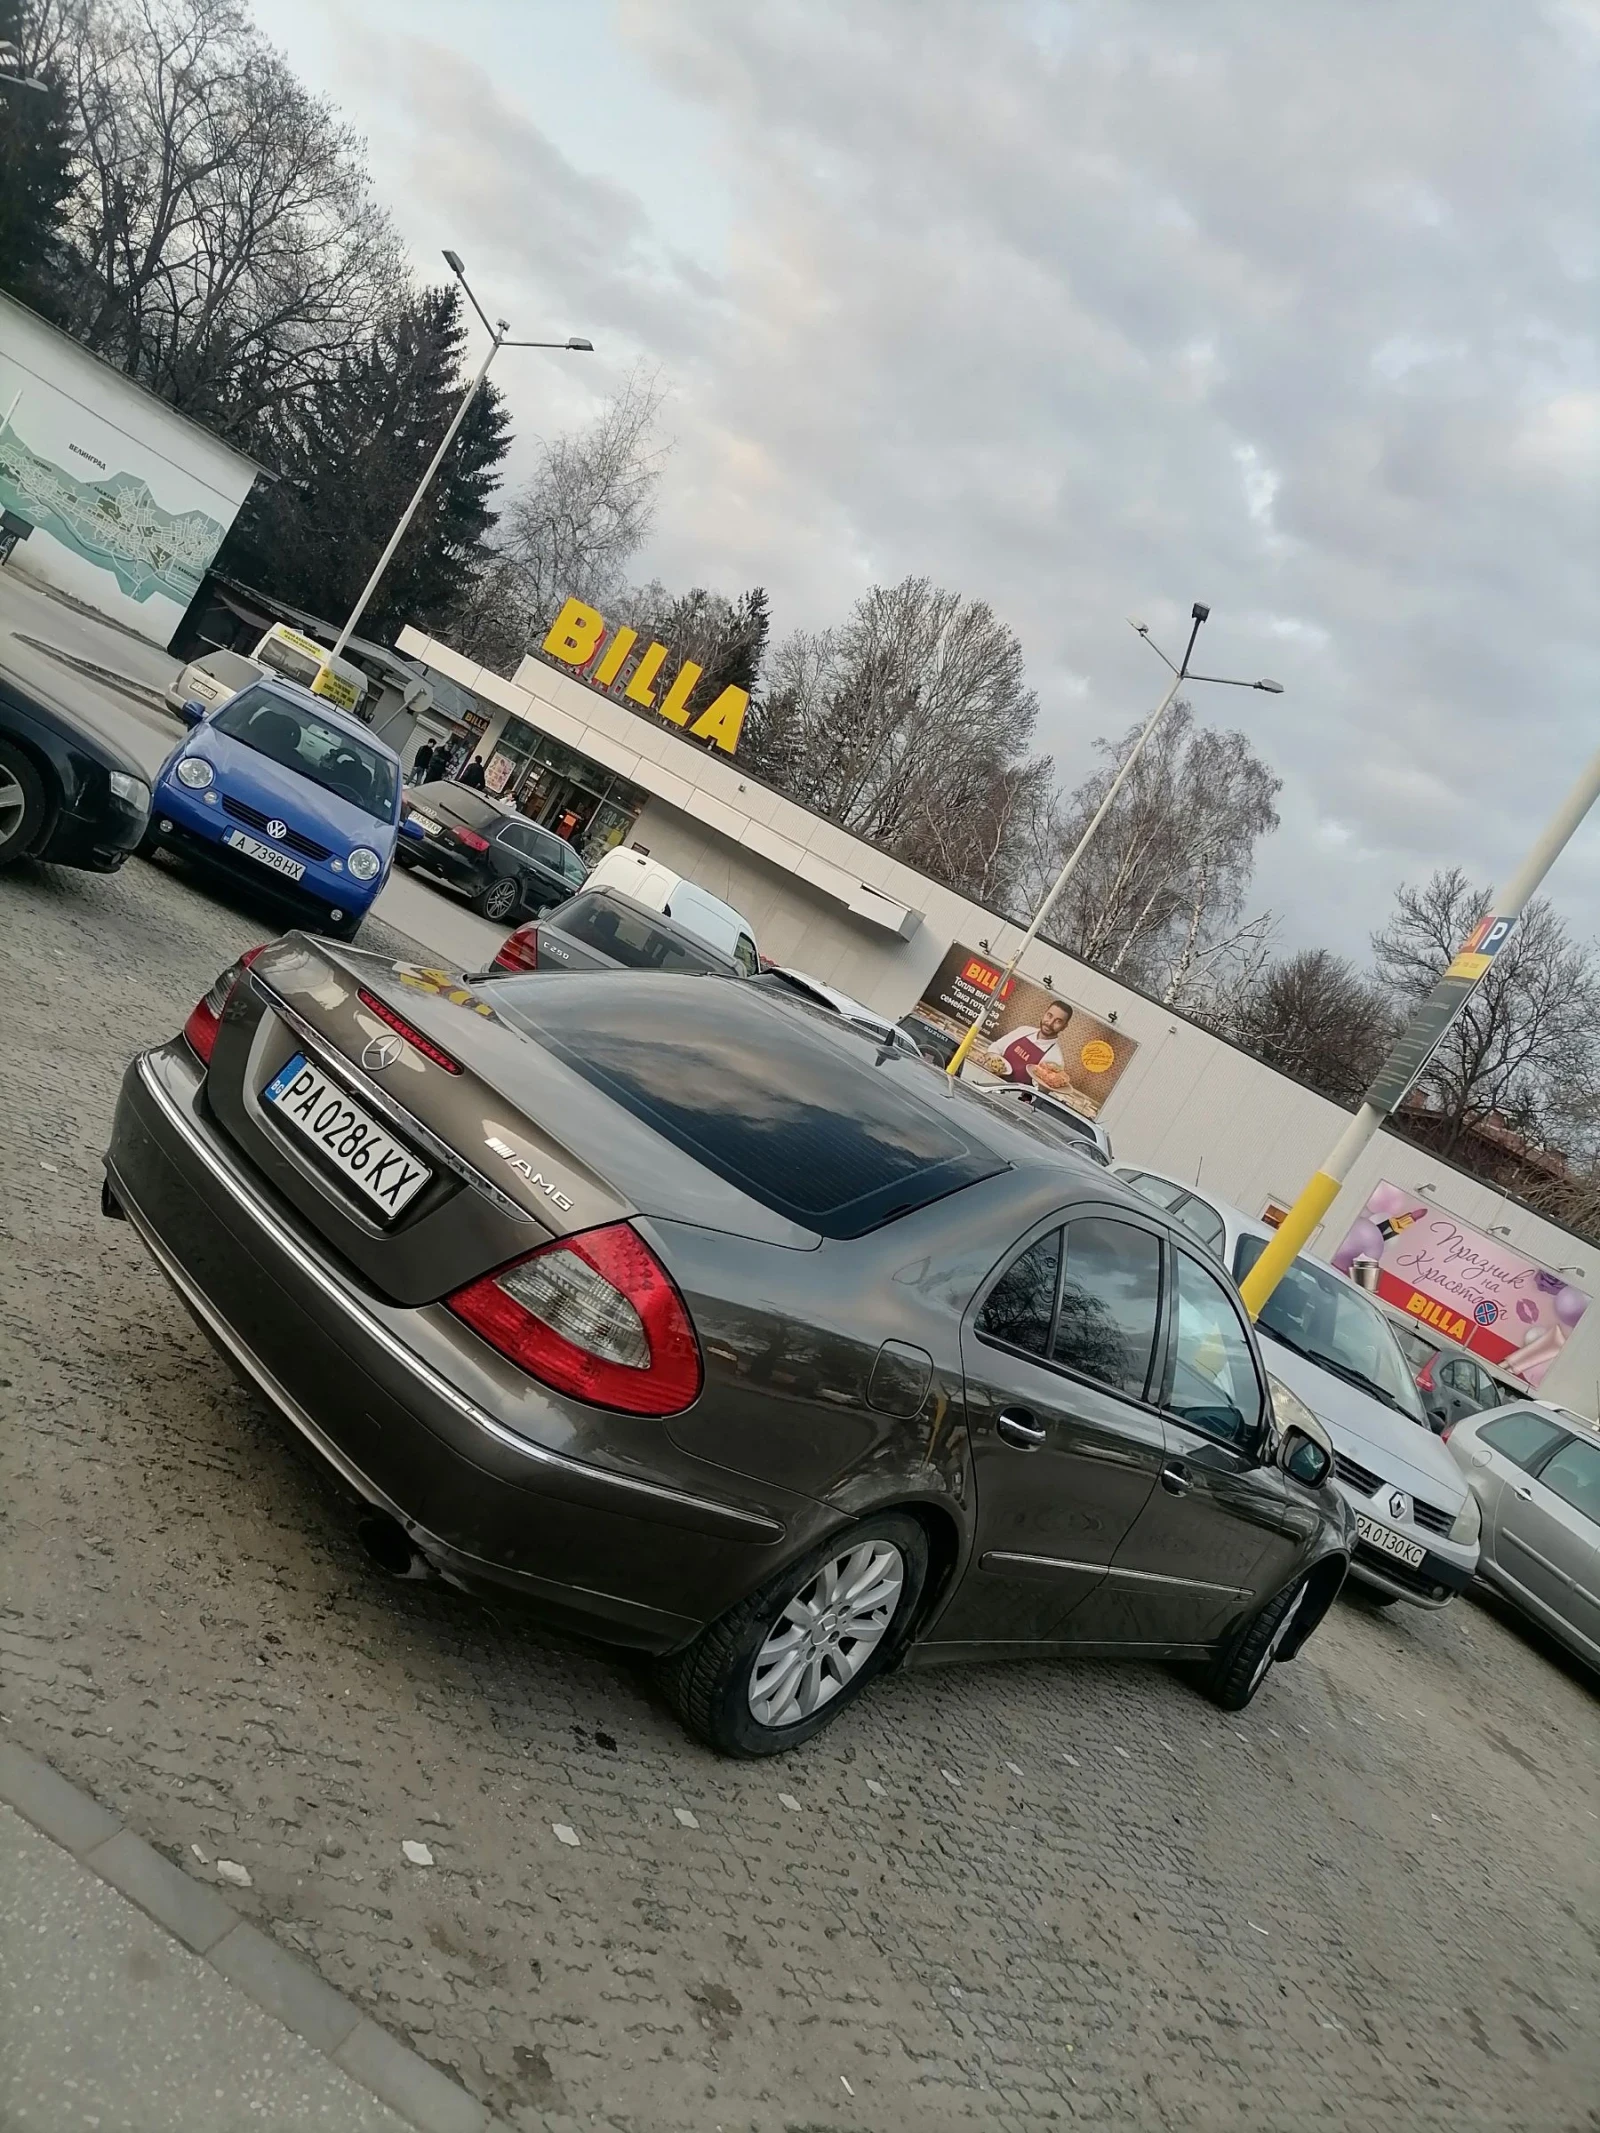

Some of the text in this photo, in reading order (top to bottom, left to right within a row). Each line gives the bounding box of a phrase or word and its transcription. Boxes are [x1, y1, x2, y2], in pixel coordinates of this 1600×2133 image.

[69, 443, 107, 471] ВЕЛИНГРАД
[542, 596, 750, 755] BILLA
[465, 712, 488, 731] BILLA
[1481, 921, 1508, 950] P
[940, 994, 980, 1019] семейство
[954, 976, 1006, 1011] Топла витна
[989, 1010, 1000, 1019] за
[924, 1025, 948, 1042] SUZUKI
[1013, 1045, 1030, 1062] BILLA
[271, 1079, 285, 1095] BG
[511, 1159, 574, 1212] AMG
[1429, 1221, 1536, 1290] Празник
[1396, 1250, 1509, 1321] Красотаа
[1480, 1279, 1500, 1293] на
[1406, 1292, 1467, 1340] BILLA
